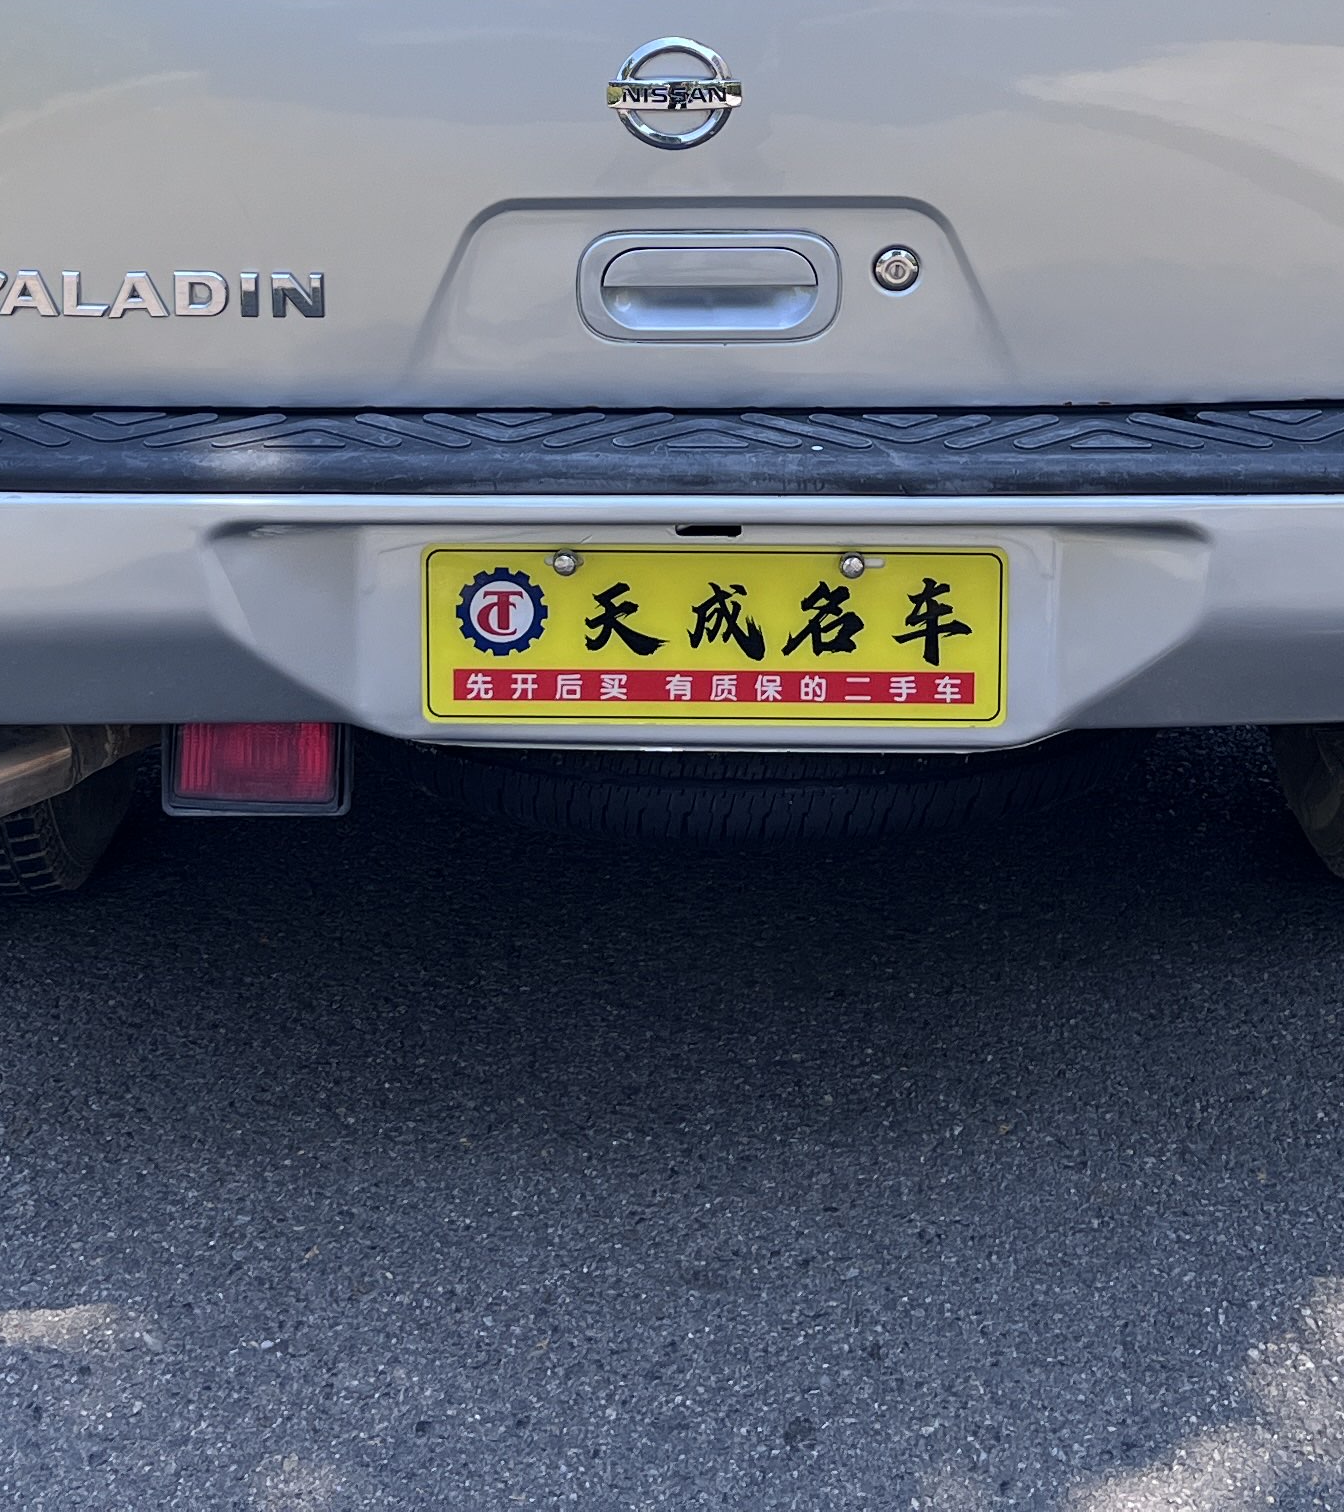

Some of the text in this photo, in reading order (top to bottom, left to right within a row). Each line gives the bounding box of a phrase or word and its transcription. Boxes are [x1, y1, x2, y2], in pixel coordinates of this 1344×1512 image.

[622, 86, 728, 104] NISSAN
[584, 577, 974, 667] 天成名车
[465, 672, 963, 704] 先开后买 有质保的二手车
